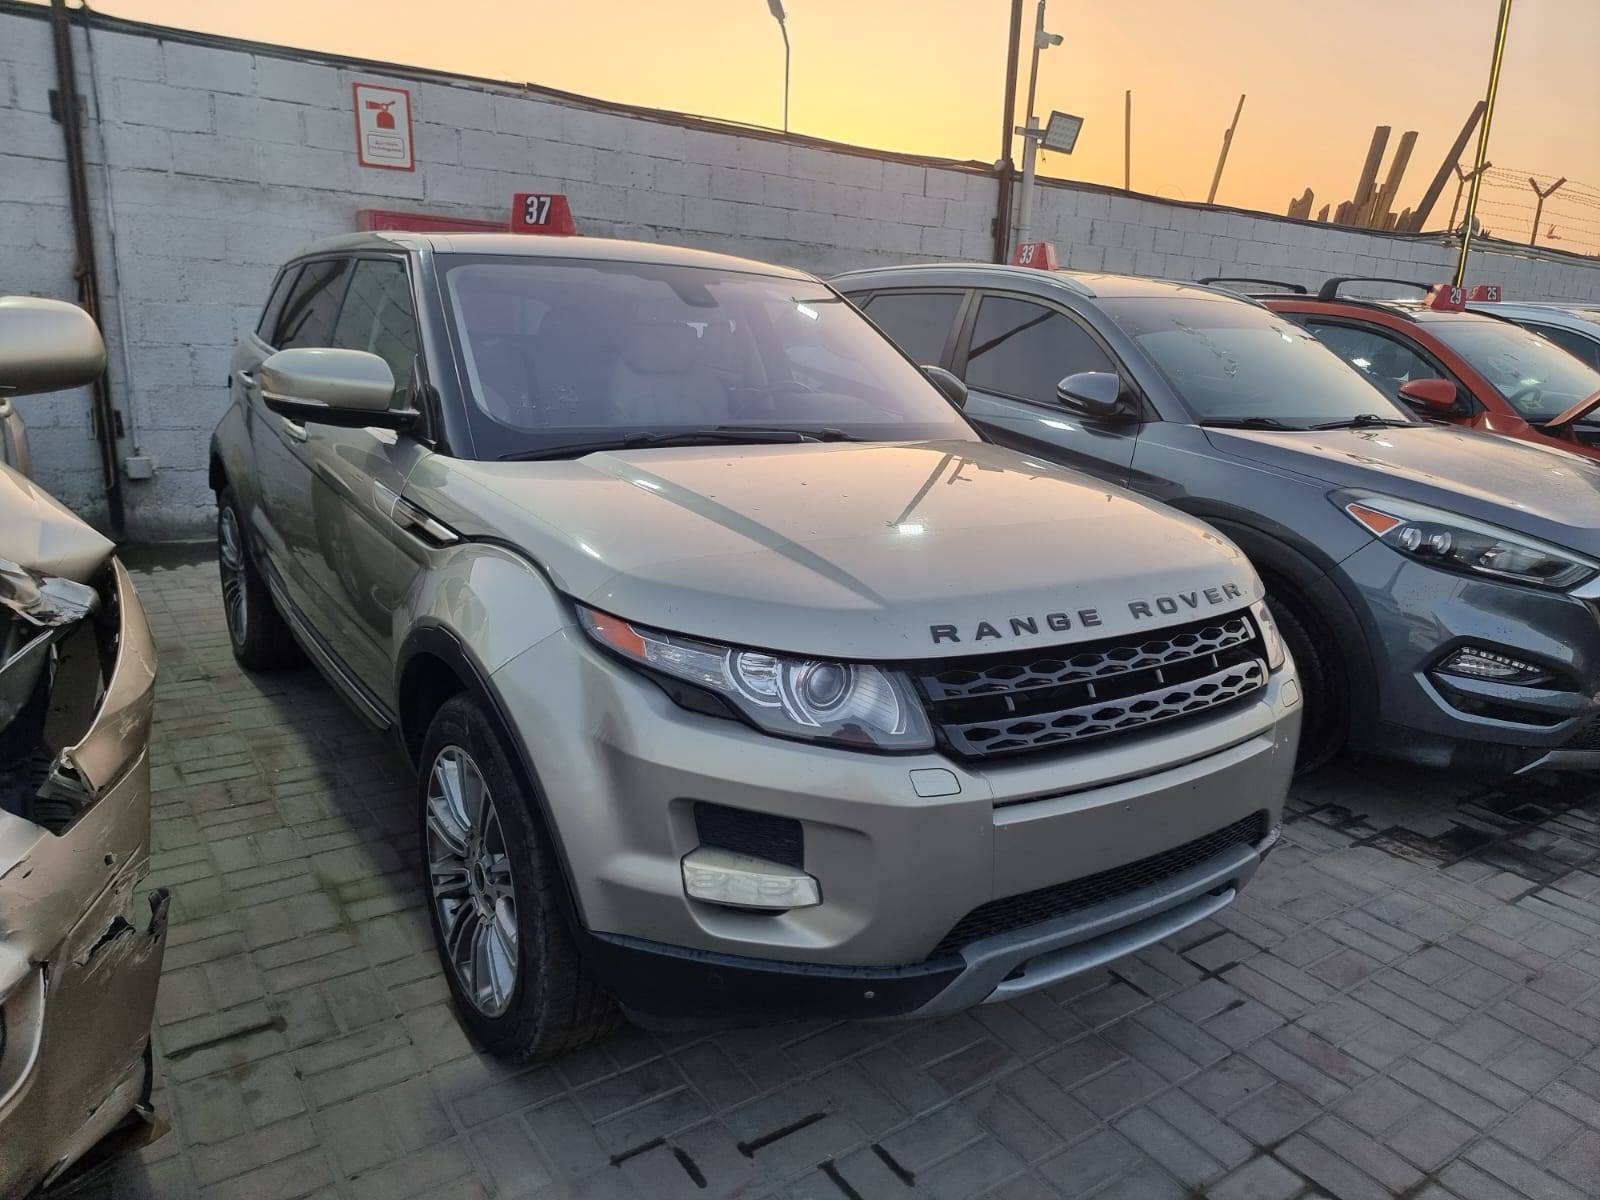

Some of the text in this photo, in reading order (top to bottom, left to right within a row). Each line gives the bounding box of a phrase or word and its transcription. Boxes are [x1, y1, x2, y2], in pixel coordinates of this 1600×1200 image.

[525, 196, 551, 225] 37
[1019, 244, 1035, 264] 33
[1450, 287, 1462, 304] 29
[1487, 287, 1497, 300] 25
[930, 582, 1242, 644] RANGE ROVER
